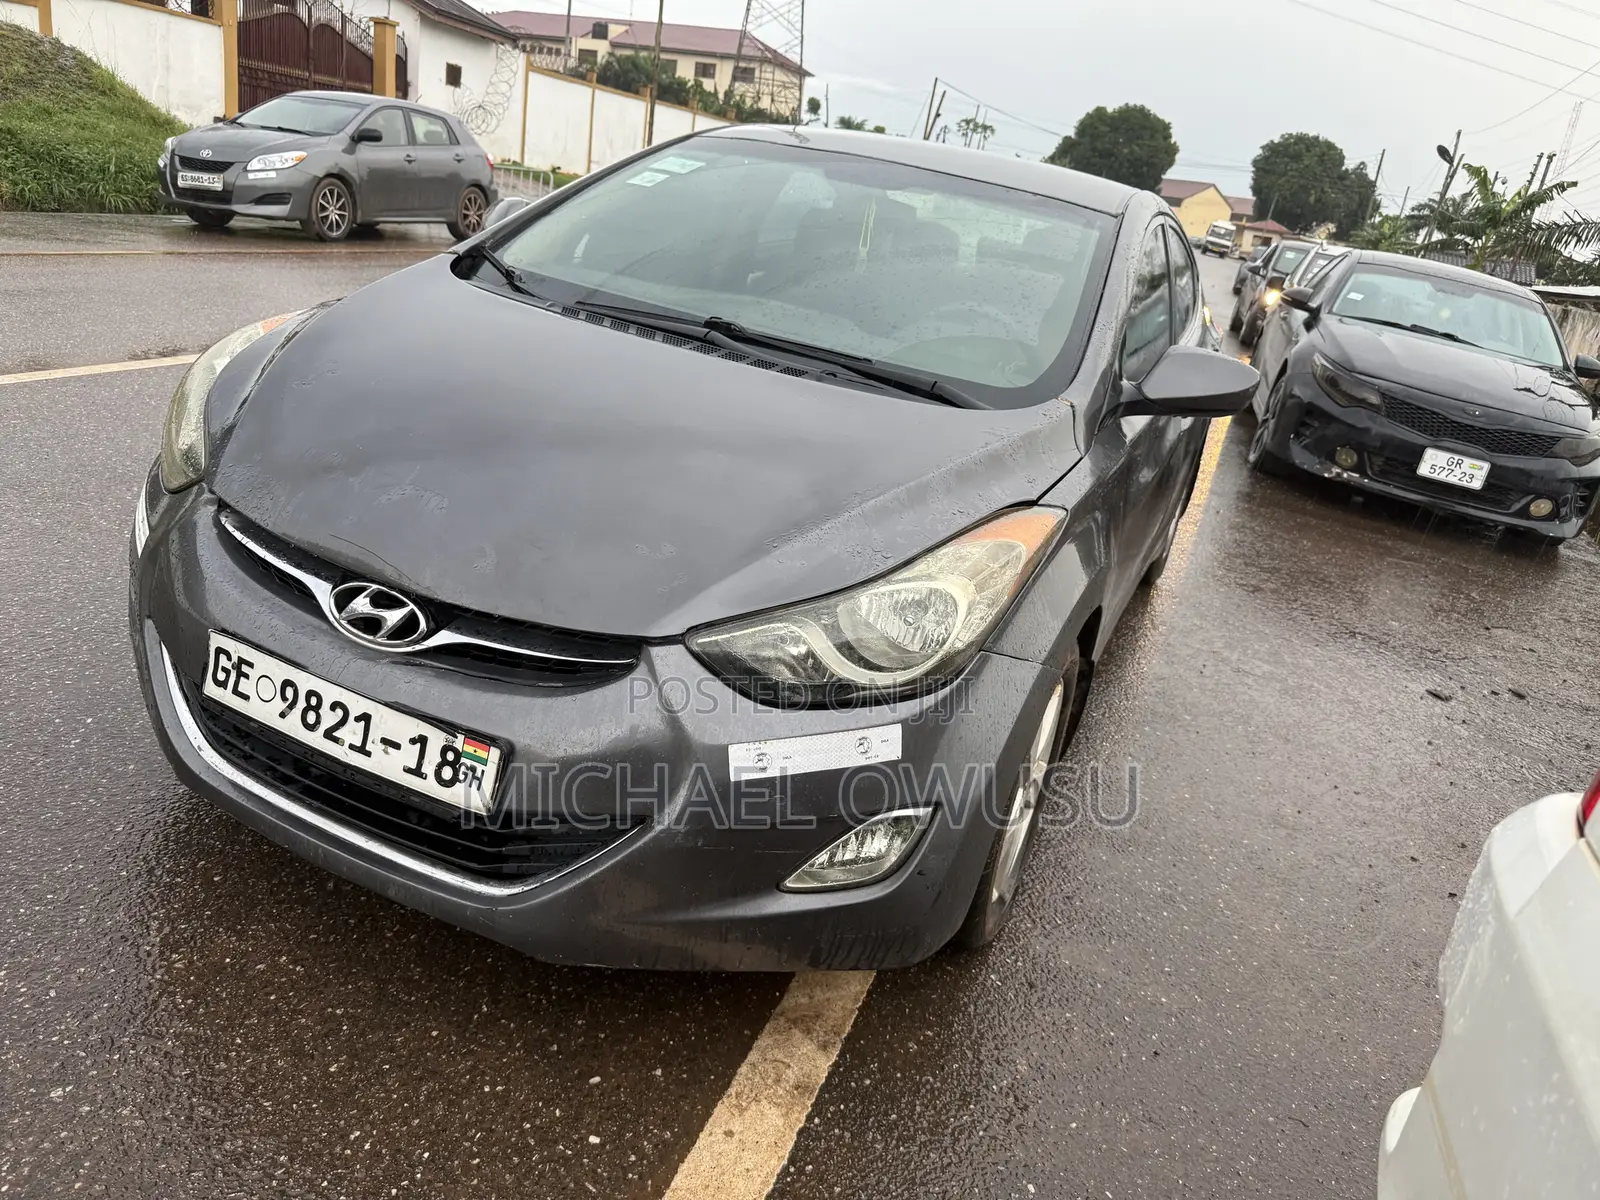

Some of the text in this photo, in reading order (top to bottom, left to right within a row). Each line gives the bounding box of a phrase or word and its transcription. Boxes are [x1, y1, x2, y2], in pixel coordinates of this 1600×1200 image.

[1428, 464, 1475, 484] 577-23
[1446, 456, 1464, 470] GR
[211, 645, 462, 788] GE 9821-18
[458, 762, 485, 791] GH
